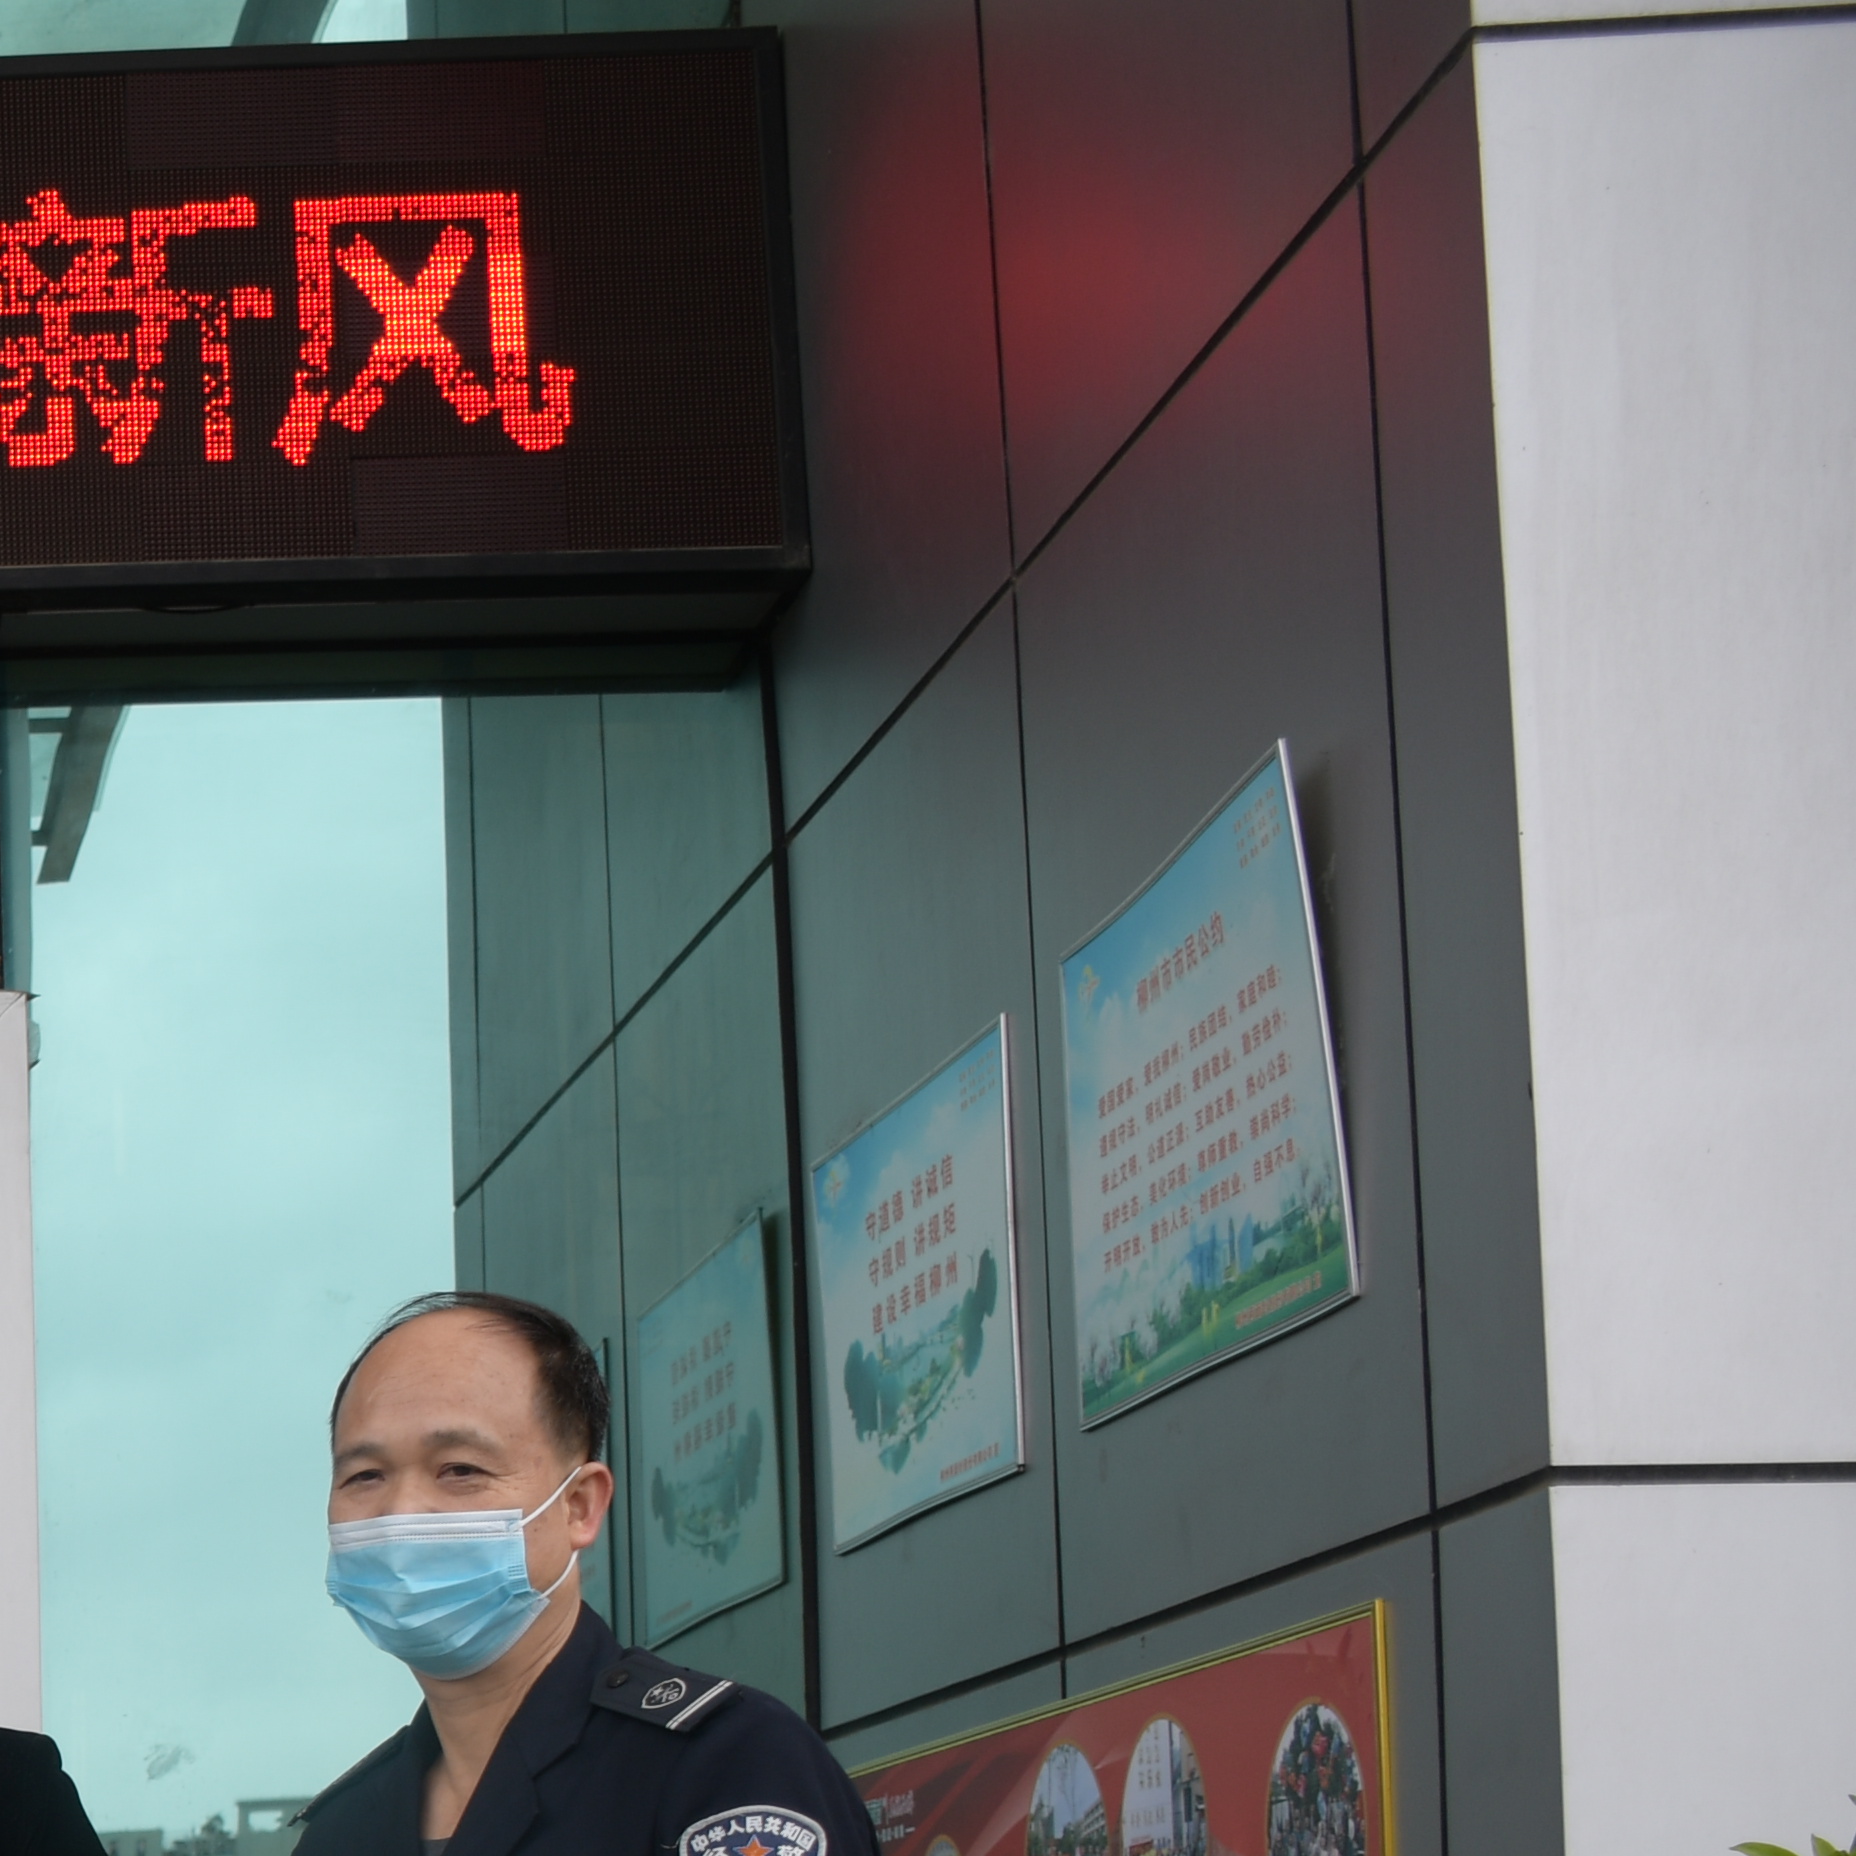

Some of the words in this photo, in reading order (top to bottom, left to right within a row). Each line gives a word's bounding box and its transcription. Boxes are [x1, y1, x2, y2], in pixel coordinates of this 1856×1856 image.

[1137, 910, 1224, 1014] 柳州市市民公约
[865, 1189, 904, 1241] 守道德
[911, 1154, 954, 1208] 讲诚信
[868, 1236, 906, 1287] 守规则
[914, 1202, 956, 1256] 讲规矩
[872, 1251, 958, 1335] 建设幸福柳州
[690, 1815, 817, 1853] 中华人民共和国
